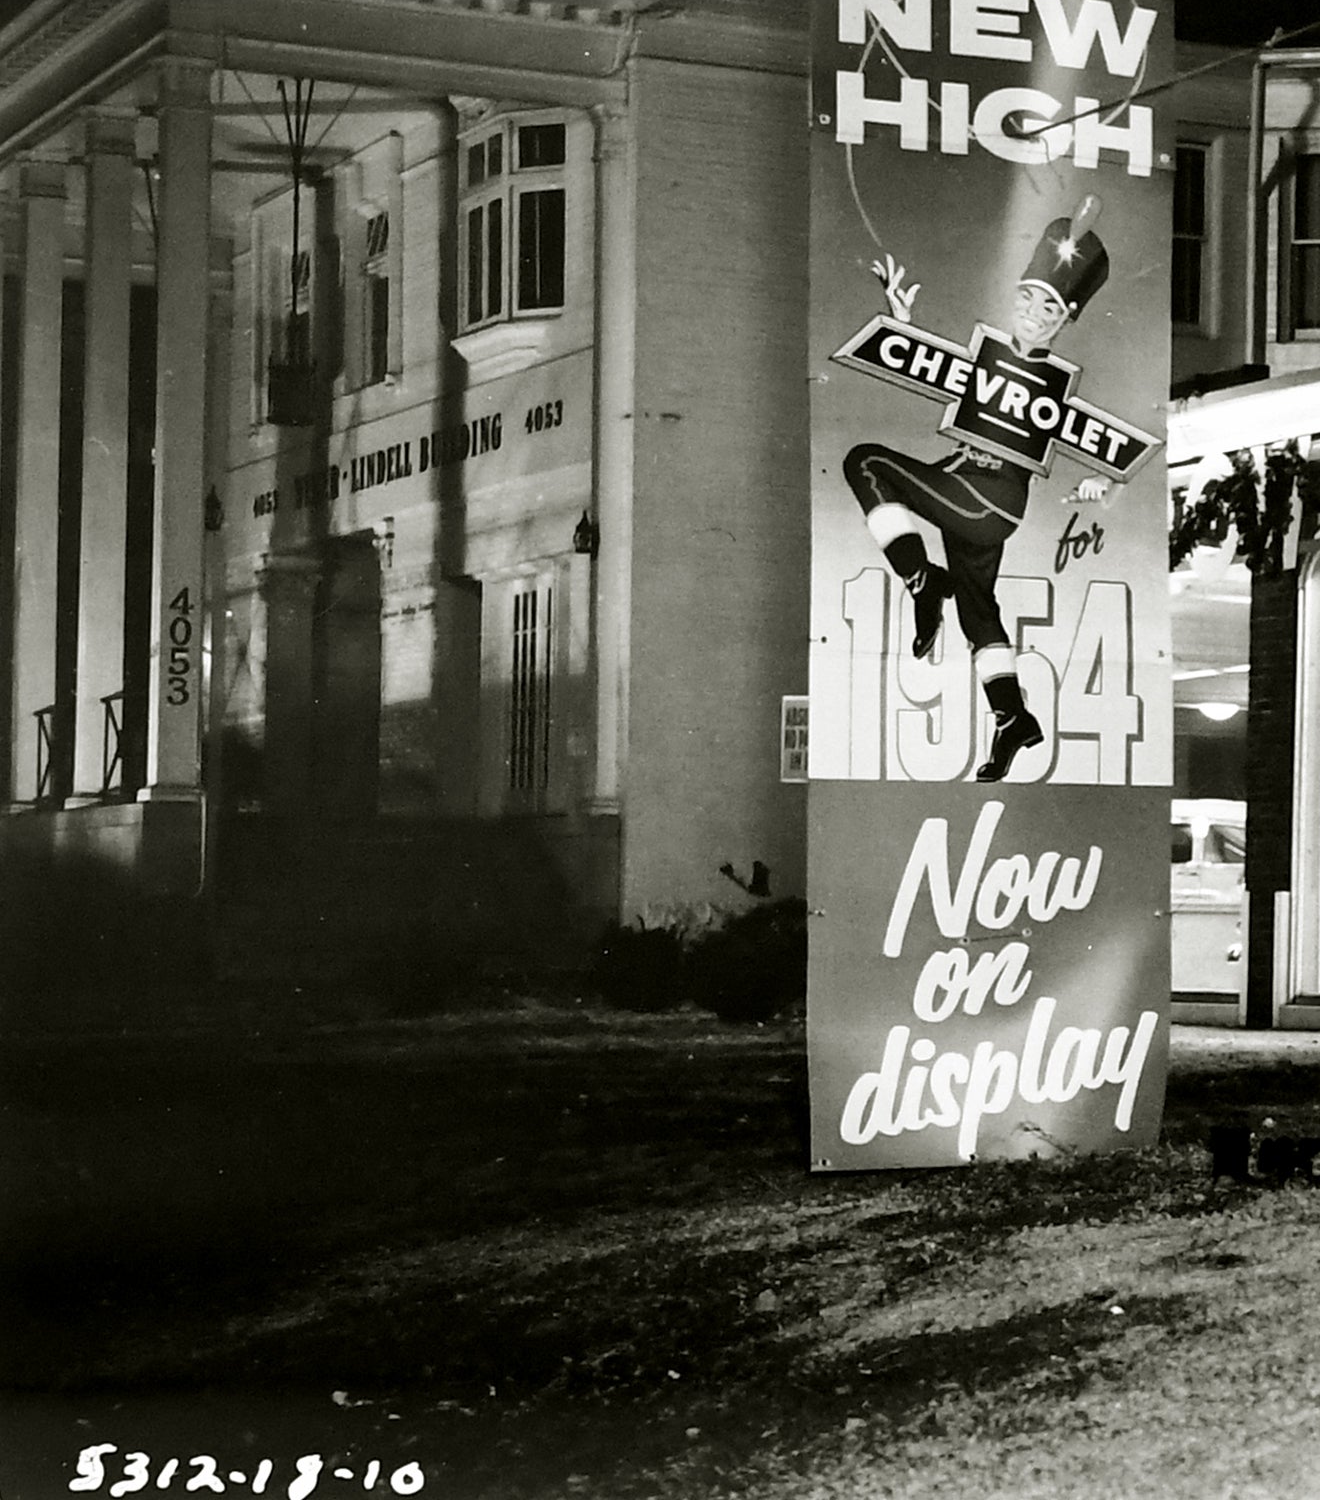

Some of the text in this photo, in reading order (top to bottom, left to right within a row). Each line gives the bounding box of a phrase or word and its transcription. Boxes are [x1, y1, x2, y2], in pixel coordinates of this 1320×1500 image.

[835, 70, 1154, 177] HIGH
[419, 412, 503, 474] BUDING
[524, 399, 564, 435] 4053
[879, 334, 1129, 465] CHEVROLET
[1054, 512, 1105, 575] for
[166, 586, 195, 707] 4053
[842, 566, 1144, 785] 1954
[882, 800, 1103, 958] Now
[913, 941, 1033, 1023] on
[840, 996, 1159, 1161] display
